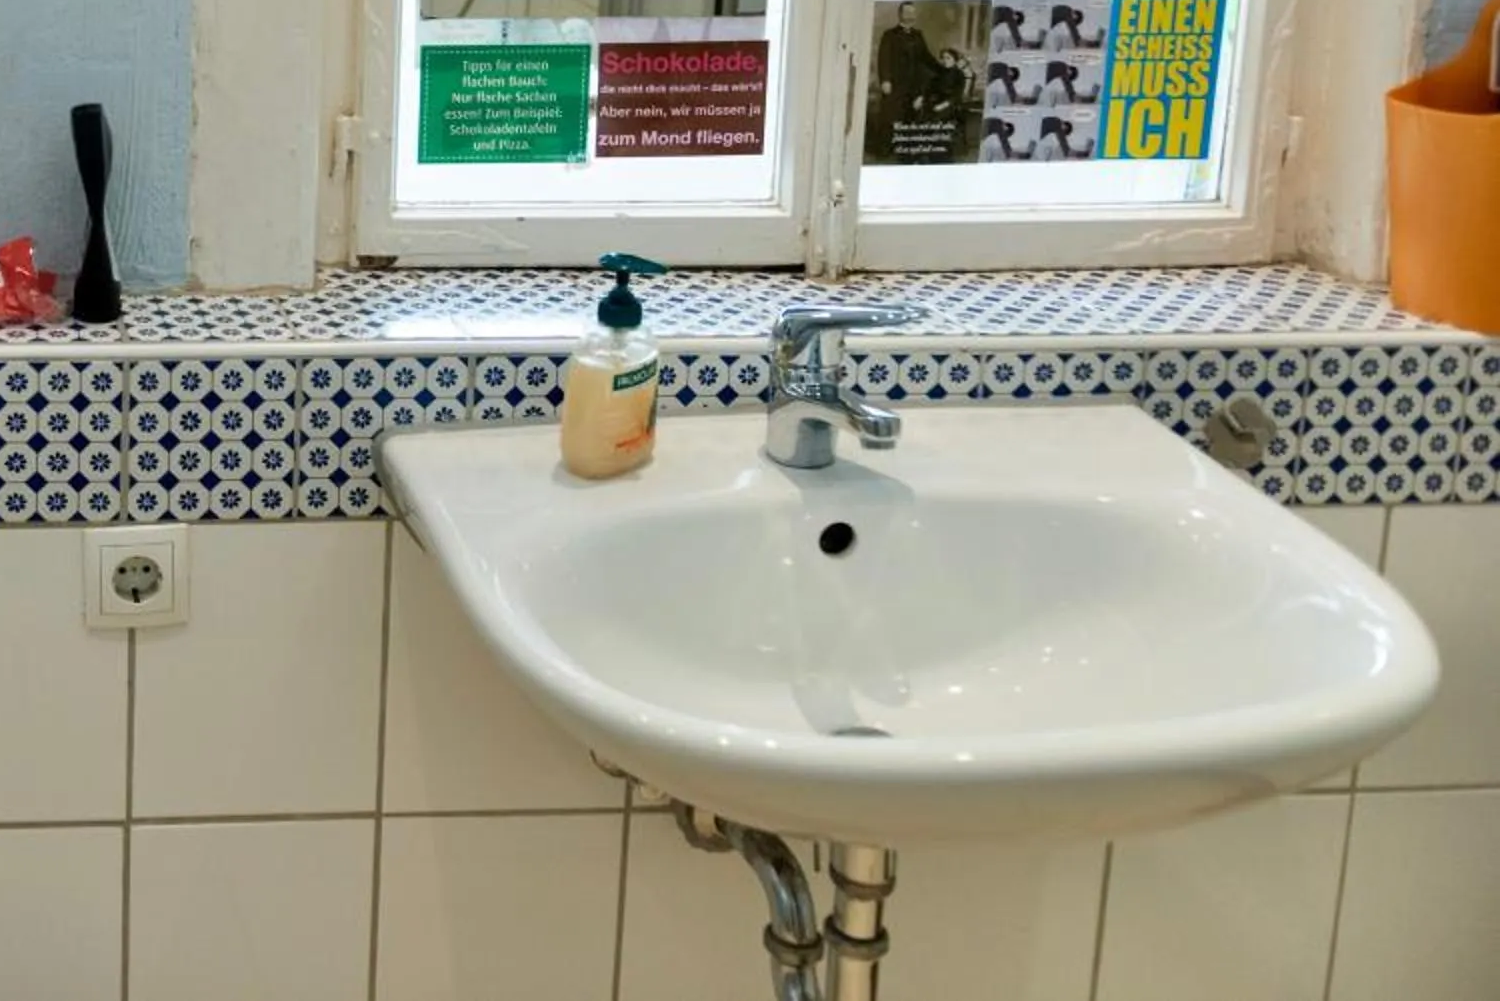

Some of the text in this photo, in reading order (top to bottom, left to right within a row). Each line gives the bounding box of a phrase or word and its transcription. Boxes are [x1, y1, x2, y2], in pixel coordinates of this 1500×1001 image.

[1115, 34, 1213, 60] SCHEISS
[462, 59, 549, 74] Tipps für einen
[601, 50, 764, 74] Schokolade,
[462, 74, 505, 88] flachen
[1111, 60, 1211, 97] MUSS
[451, 90, 557, 104] Nur flache Sachen
[484, 108, 511, 119] Zum
[513, 106, 563, 121] Beispiel:
[600, 103, 761, 118] Aber nein, wir müssen ja
[449, 123, 557, 135] Schokoladentafeln
[1103, 98, 1207, 158] ICH
[473, 138, 496, 151] und
[598, 129, 760, 148] zum Mond fliegen.
